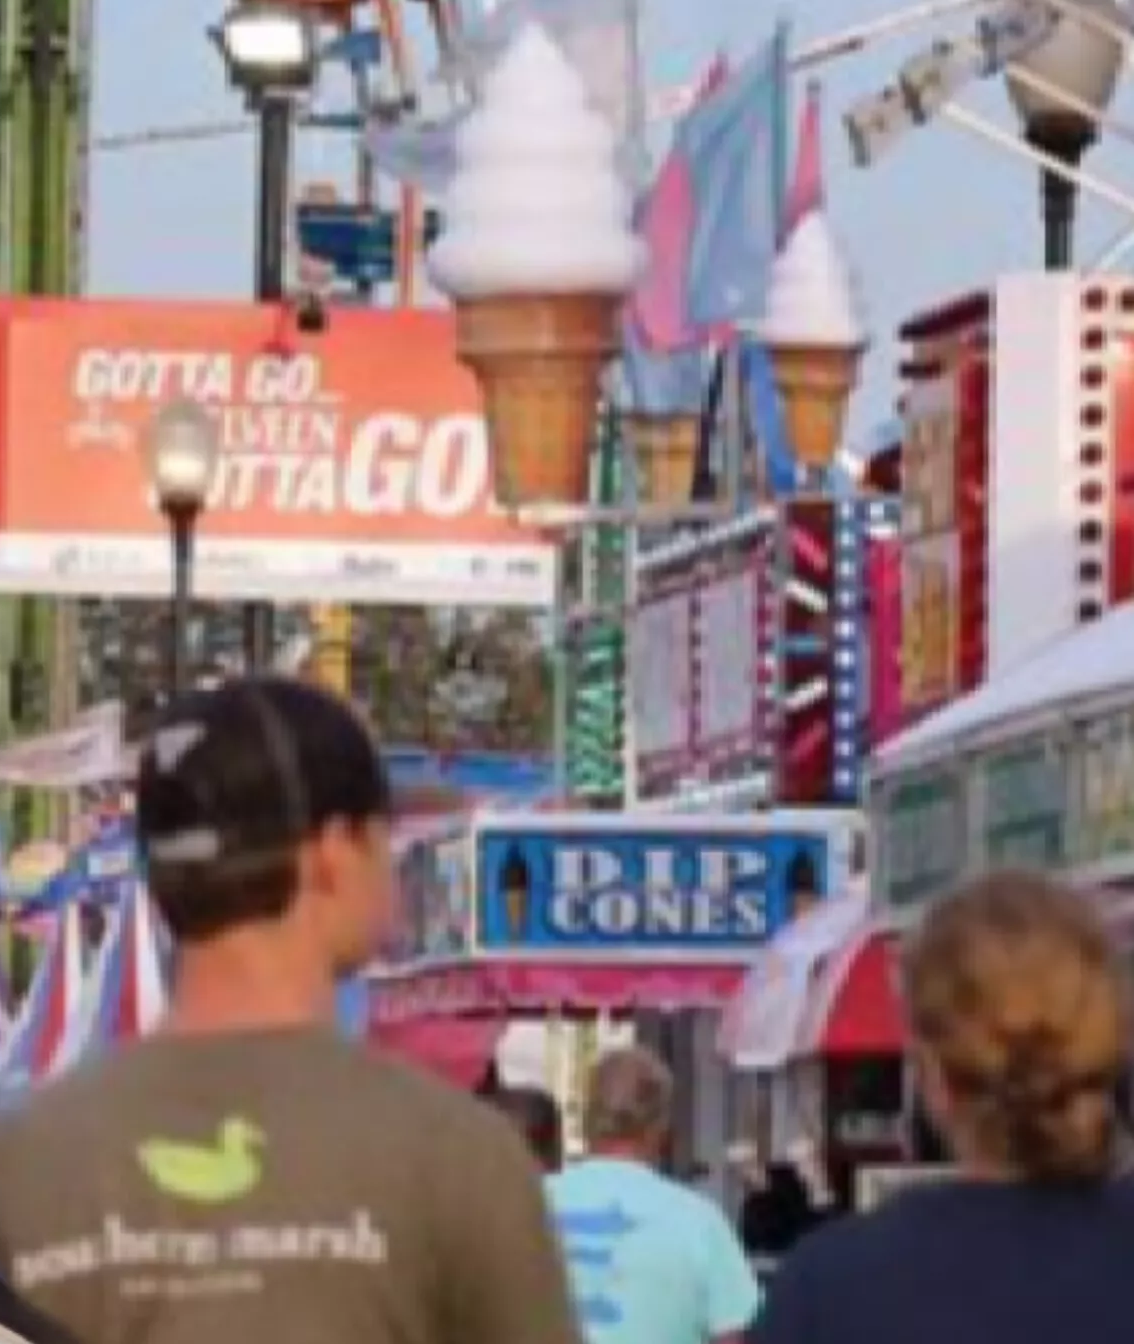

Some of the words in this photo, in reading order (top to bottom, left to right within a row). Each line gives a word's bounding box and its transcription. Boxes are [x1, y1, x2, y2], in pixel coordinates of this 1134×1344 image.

[75, 350, 232, 402] GOTTA
[552, 848, 766, 890] DIP
[551, 893, 766, 936] CONES
